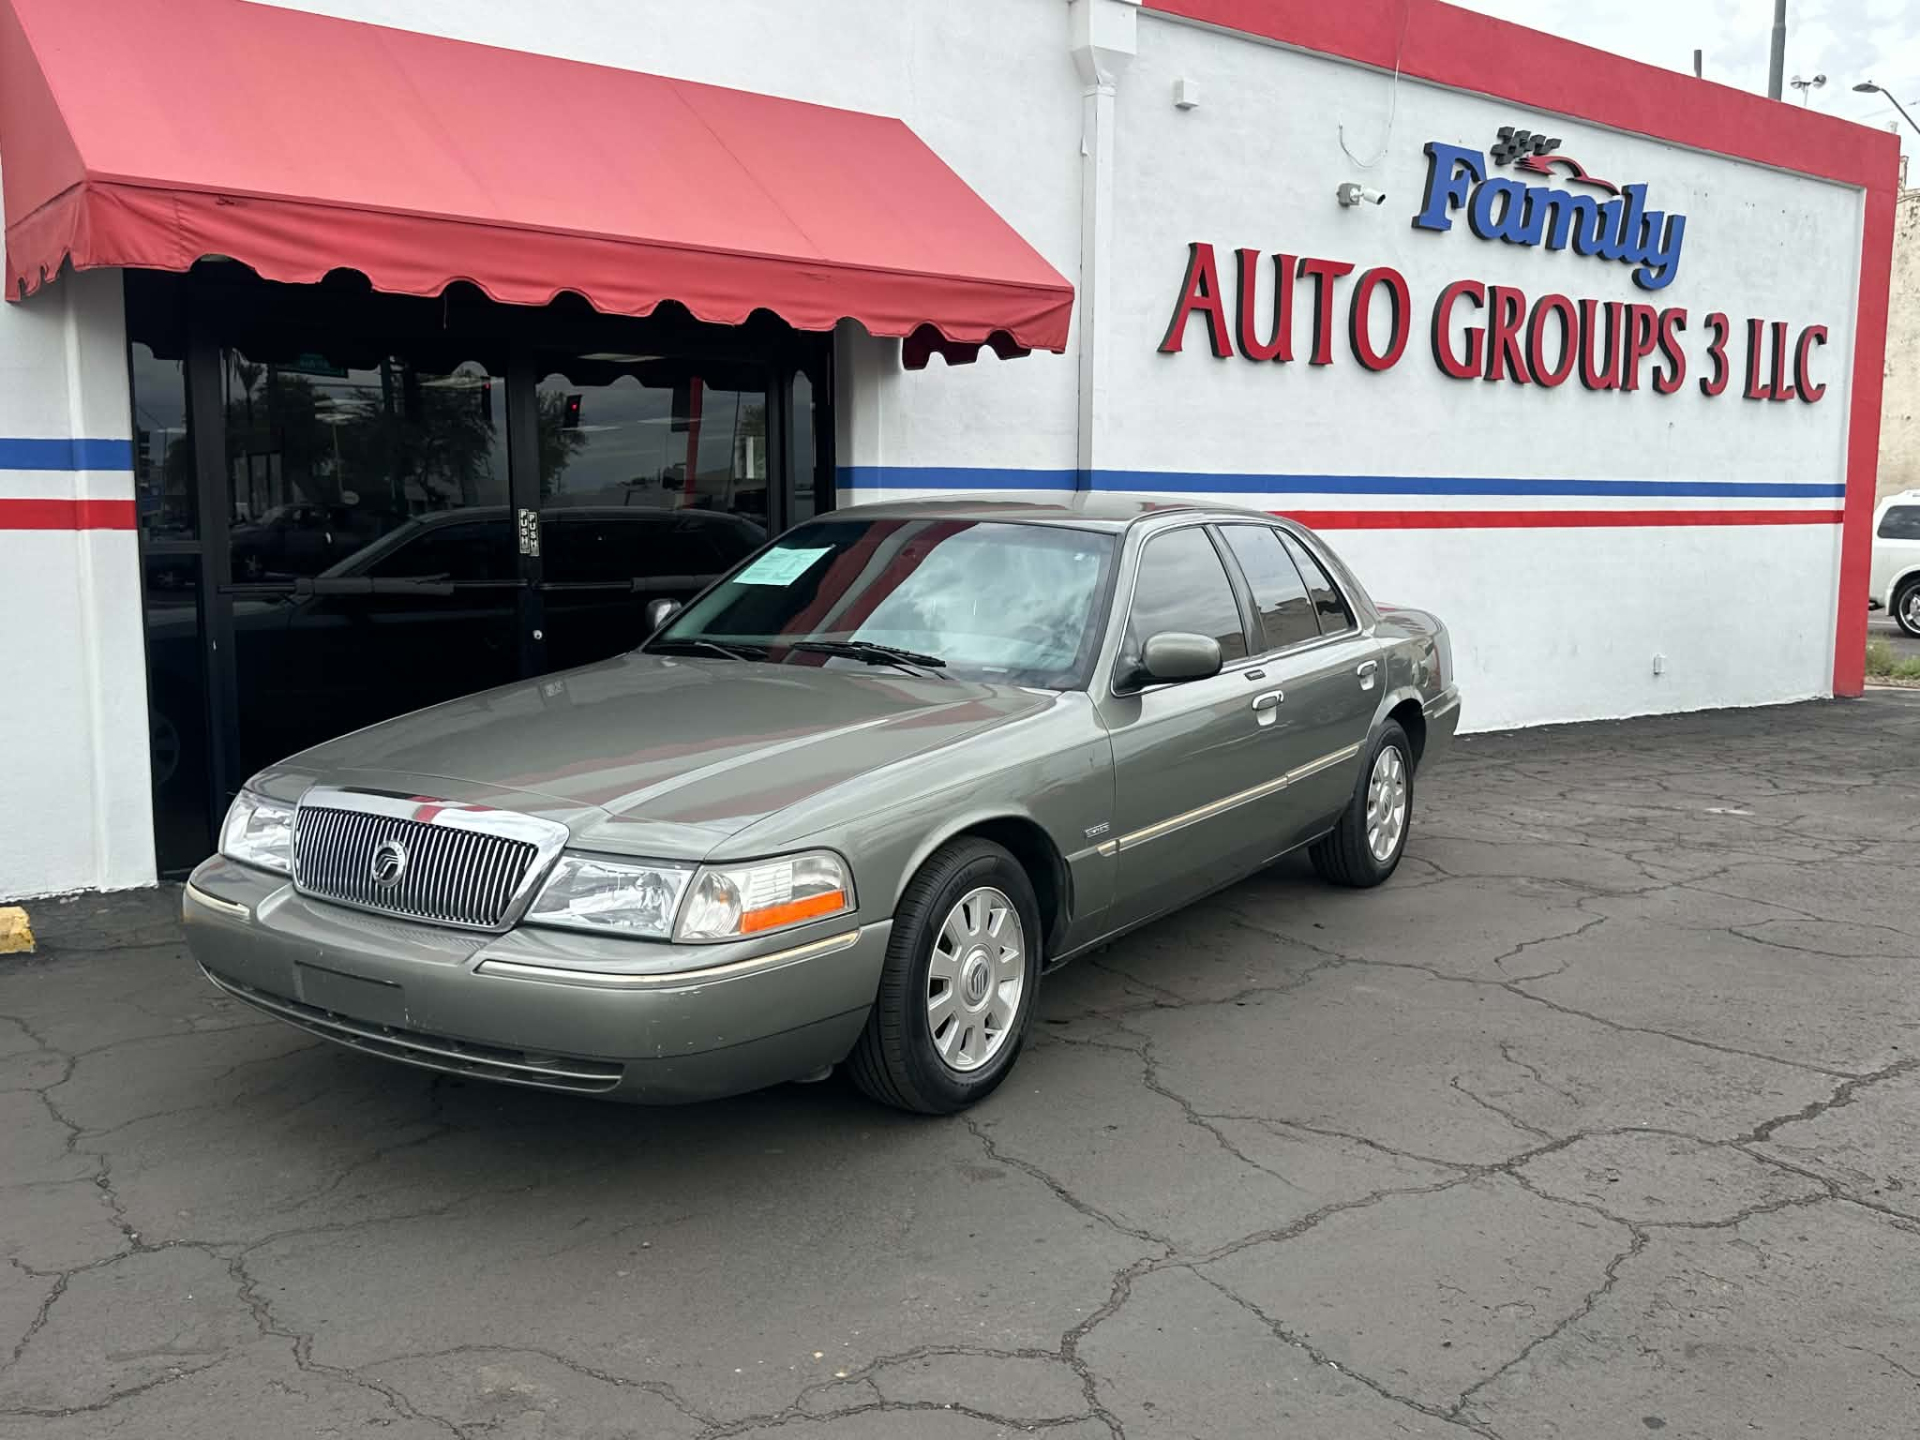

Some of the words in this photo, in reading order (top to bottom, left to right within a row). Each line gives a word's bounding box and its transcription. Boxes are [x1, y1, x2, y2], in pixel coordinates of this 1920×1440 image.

[1412, 141, 1686, 290] Family
[1157, 243, 1411, 374] AUTO
[1431, 280, 1687, 396] GROUPS
[1699, 312, 1730, 398] 3
[1743, 318, 1829, 404] LLC
[520, 511, 528, 545] PUSH
[529, 514, 537, 548] PUSH
